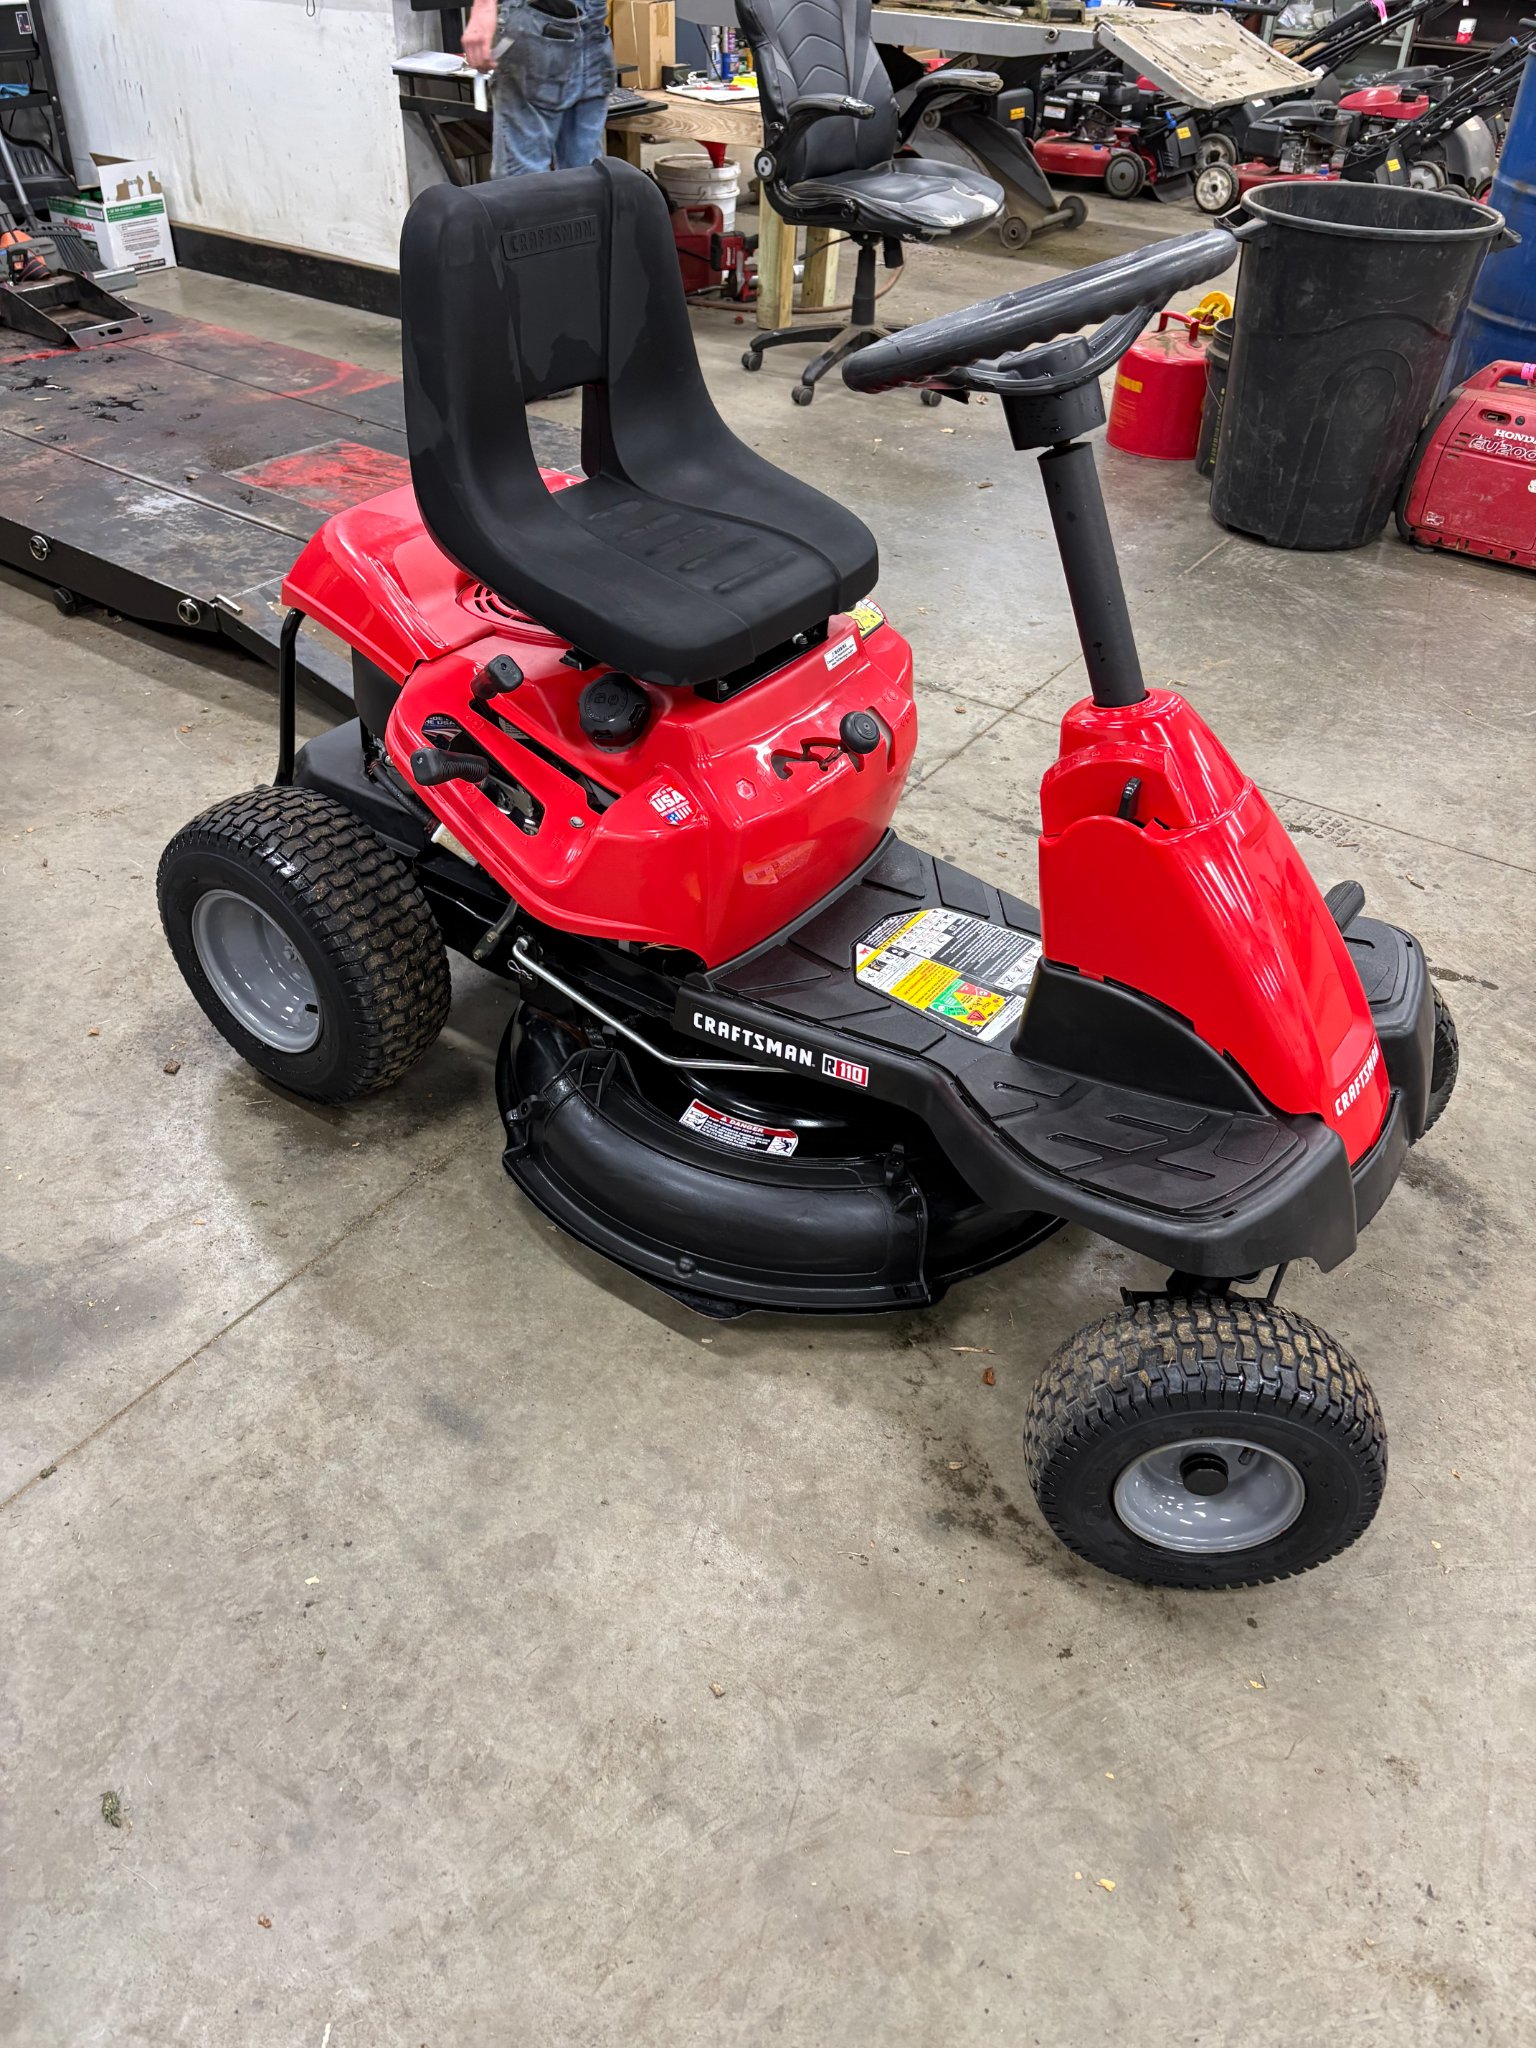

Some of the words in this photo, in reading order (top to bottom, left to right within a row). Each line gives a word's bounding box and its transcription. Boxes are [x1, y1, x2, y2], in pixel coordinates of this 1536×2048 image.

[1494, 428, 1536, 445] HOND
[651, 790, 687, 813] USA
[693, 1012, 814, 1067] CRAFTSMAN
[1334, 1042, 1380, 1117] CRAFTSMAN
[729, 1119, 765, 1133] DANGER
